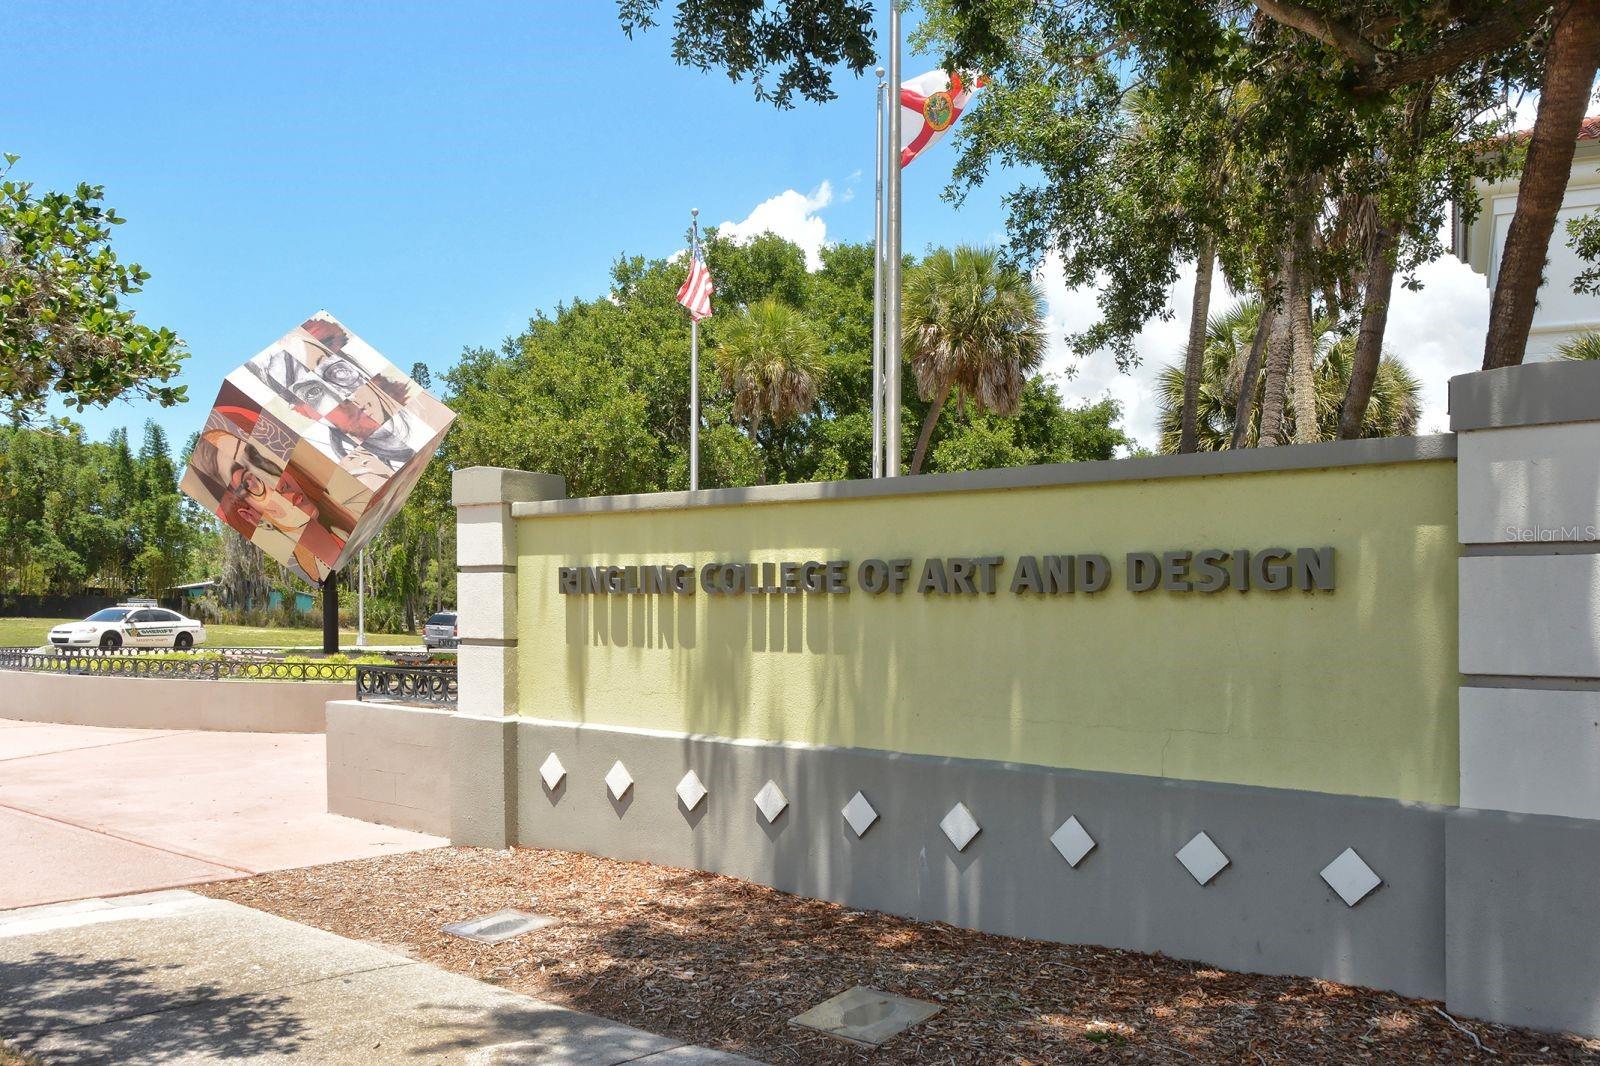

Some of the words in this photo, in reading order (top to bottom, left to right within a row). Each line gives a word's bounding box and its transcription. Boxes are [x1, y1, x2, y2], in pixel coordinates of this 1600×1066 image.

[558, 564, 696, 595] RINGLING
[700, 560, 850, 595] COLLEGE
[857, 558, 912, 594] OF
[917, 555, 1004, 594] ART
[1009, 554, 1112, 594] AND
[1125, 547, 1336, 594] DESIGN
